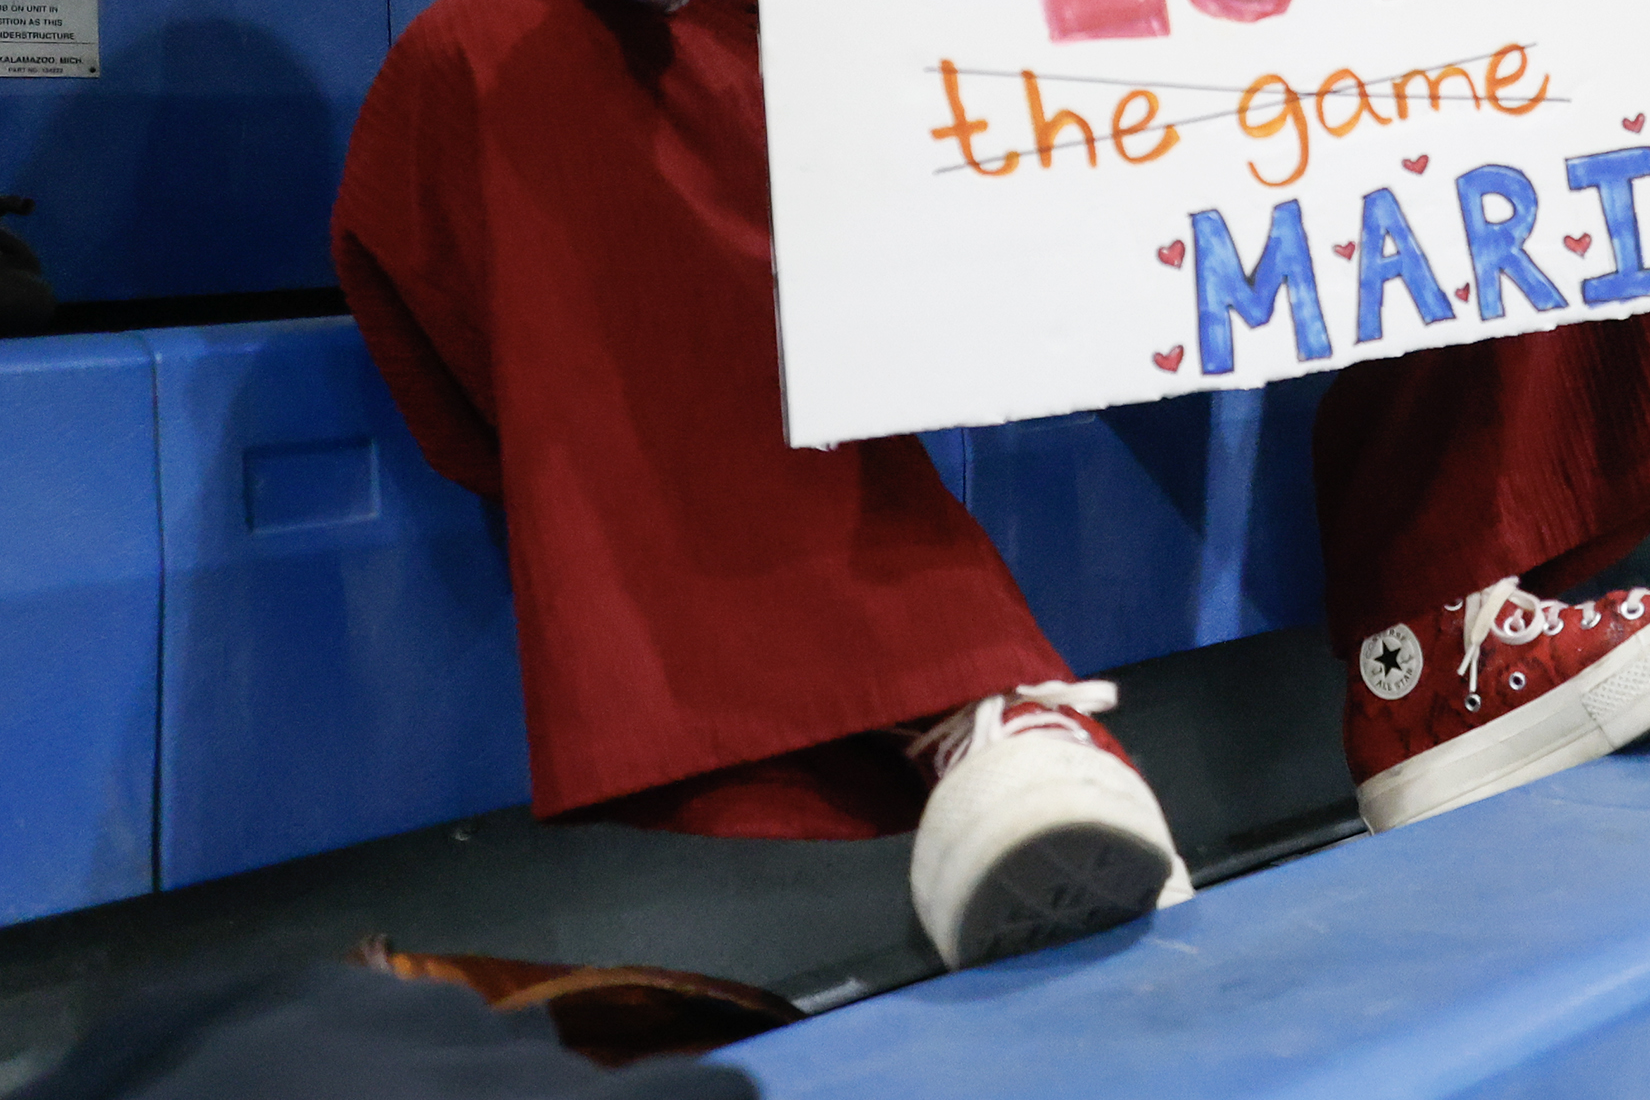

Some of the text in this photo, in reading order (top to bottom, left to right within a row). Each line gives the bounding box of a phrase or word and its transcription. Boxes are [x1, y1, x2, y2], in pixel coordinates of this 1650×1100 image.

[27, 5, 47, 13] UNIT
[49, 6, 58, 14] IN
[44, 19, 63, 27] THIS
[931, 43, 1551, 188] the game
